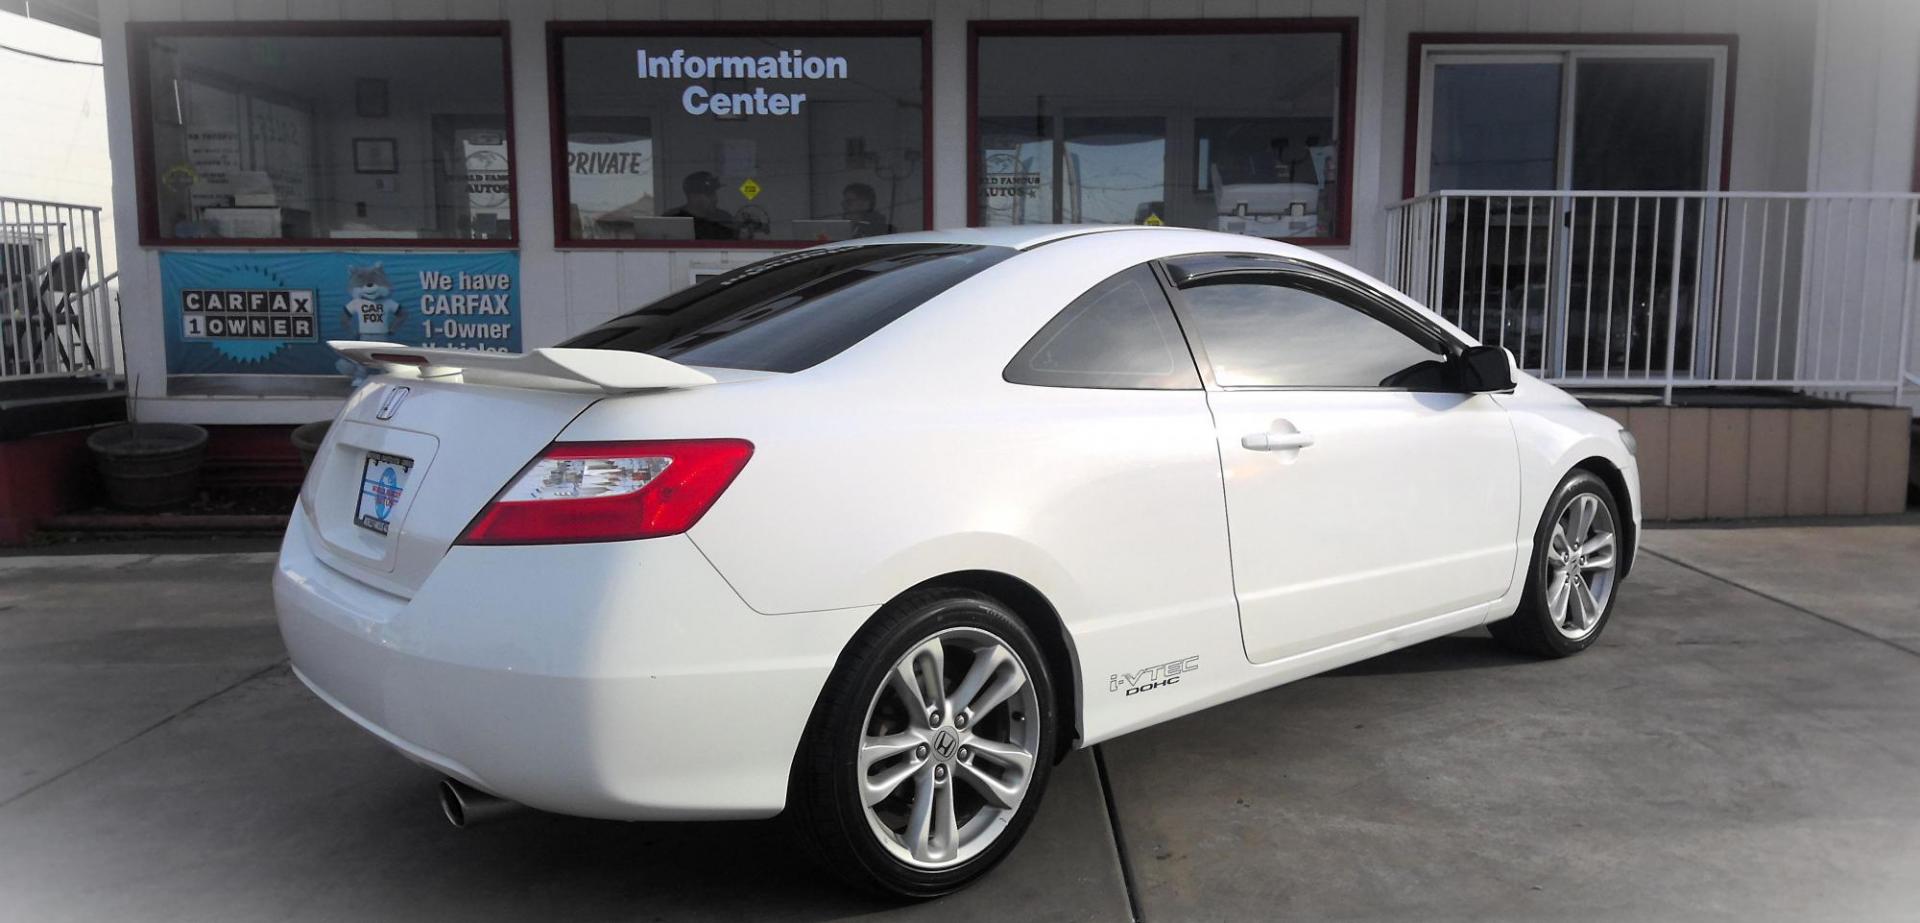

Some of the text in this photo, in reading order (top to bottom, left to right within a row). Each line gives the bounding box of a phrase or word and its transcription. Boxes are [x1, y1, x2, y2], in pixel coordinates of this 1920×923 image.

[637, 49, 848, 79] Information
[682, 85, 806, 115] Center
[568, 152, 642, 175] PRIVATE
[420, 271, 511, 290] We have
[186, 293, 308, 312] CARFAX
[361, 304, 384, 313] CAR
[421, 294, 510, 315] CARFAX
[190, 318, 310, 335] 1 OWNER
[363, 313, 384, 323] FOX
[423, 319, 511, 338] 1-Owner
[1110, 655, 1200, 692] i-VTEC
[1126, 676, 1180, 696] DOHC
